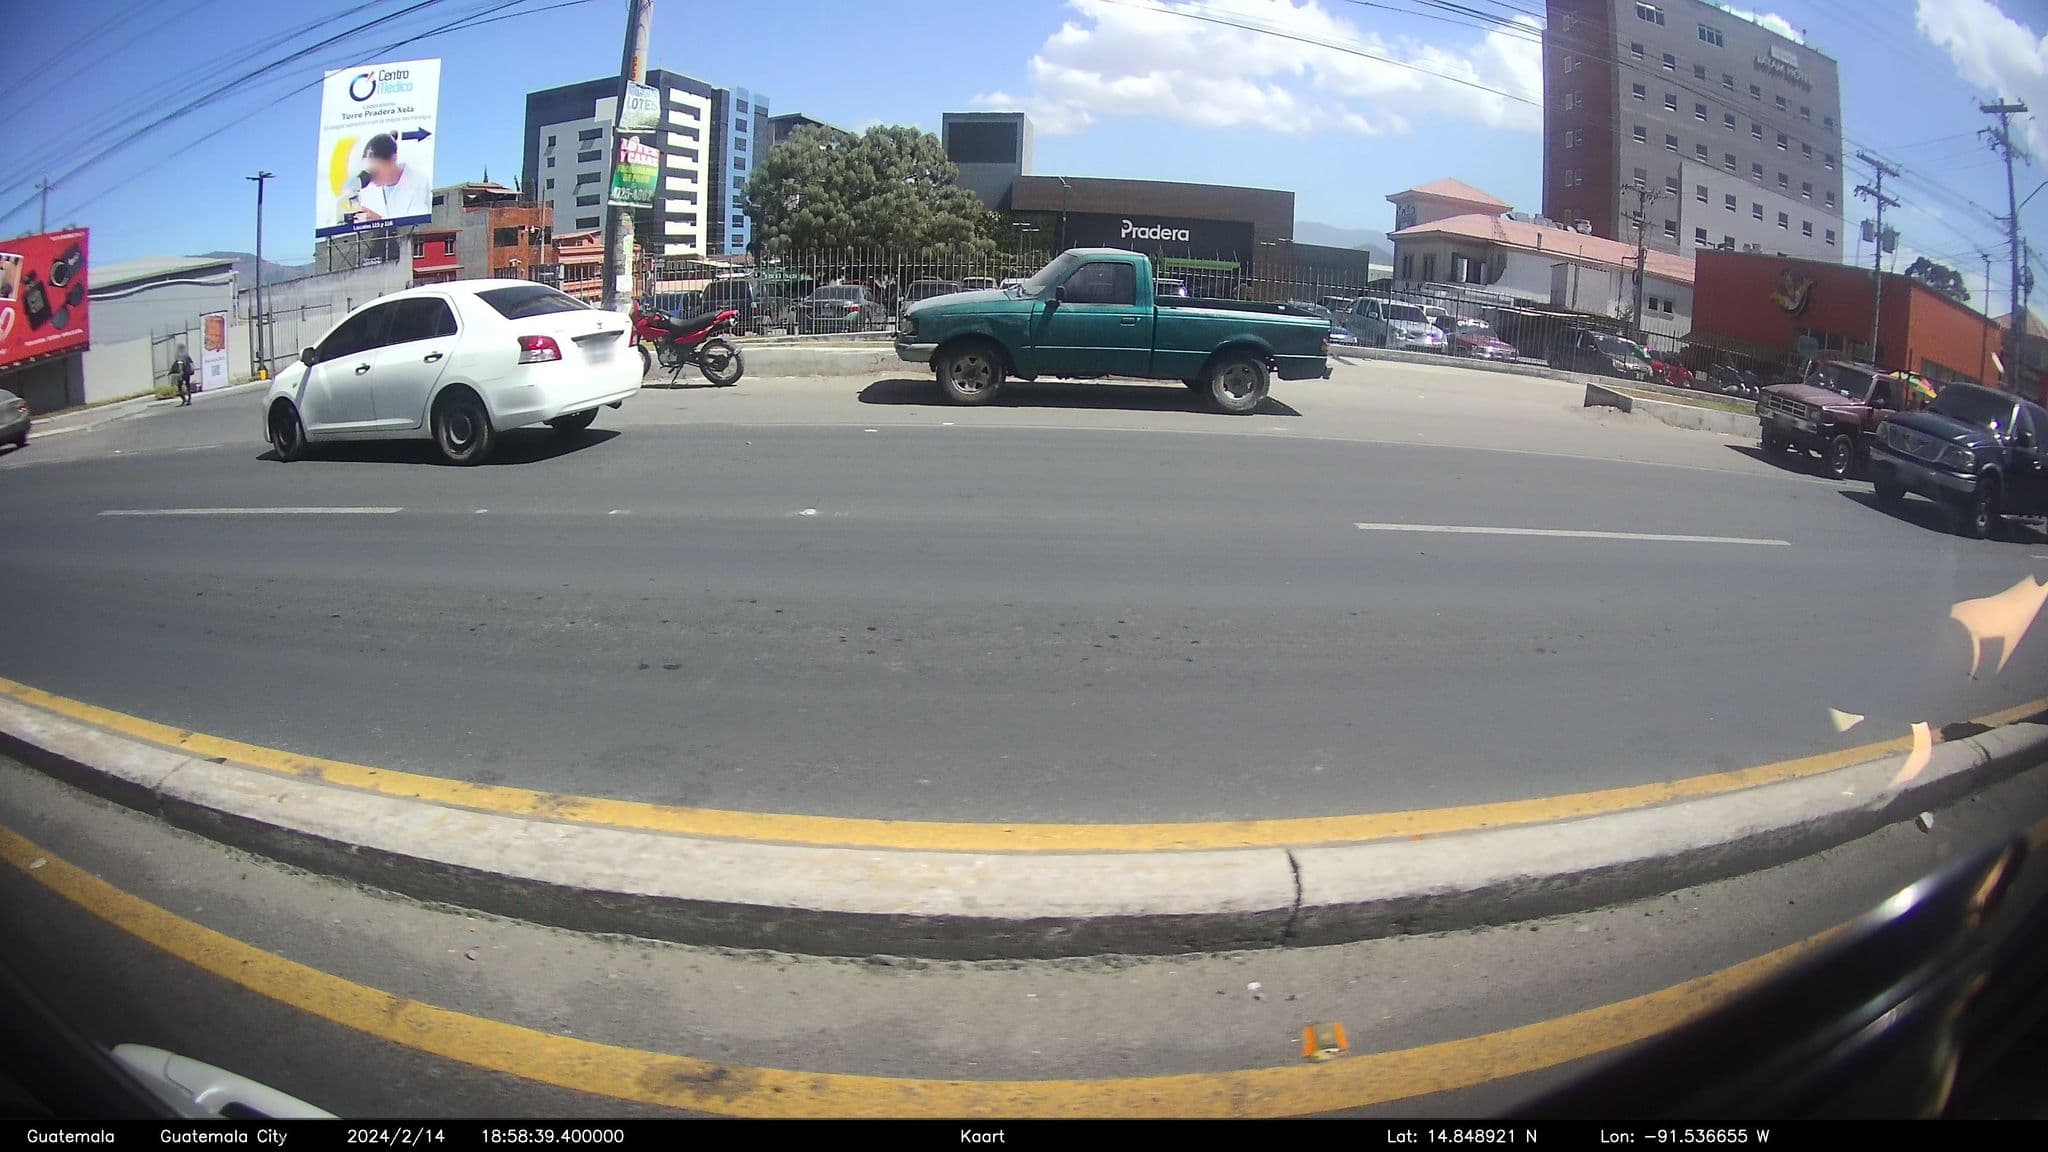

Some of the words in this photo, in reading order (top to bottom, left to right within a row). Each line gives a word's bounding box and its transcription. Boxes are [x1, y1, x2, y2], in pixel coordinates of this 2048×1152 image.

[379, 69, 409, 82] Centro
[626, 96, 658, 111] LOTES
[341, 112, 363, 121] Torre
[364, 107, 396, 118] Pradera
[397, 105, 415, 114] Xela
[1121, 220, 1189, 242] Pradera
